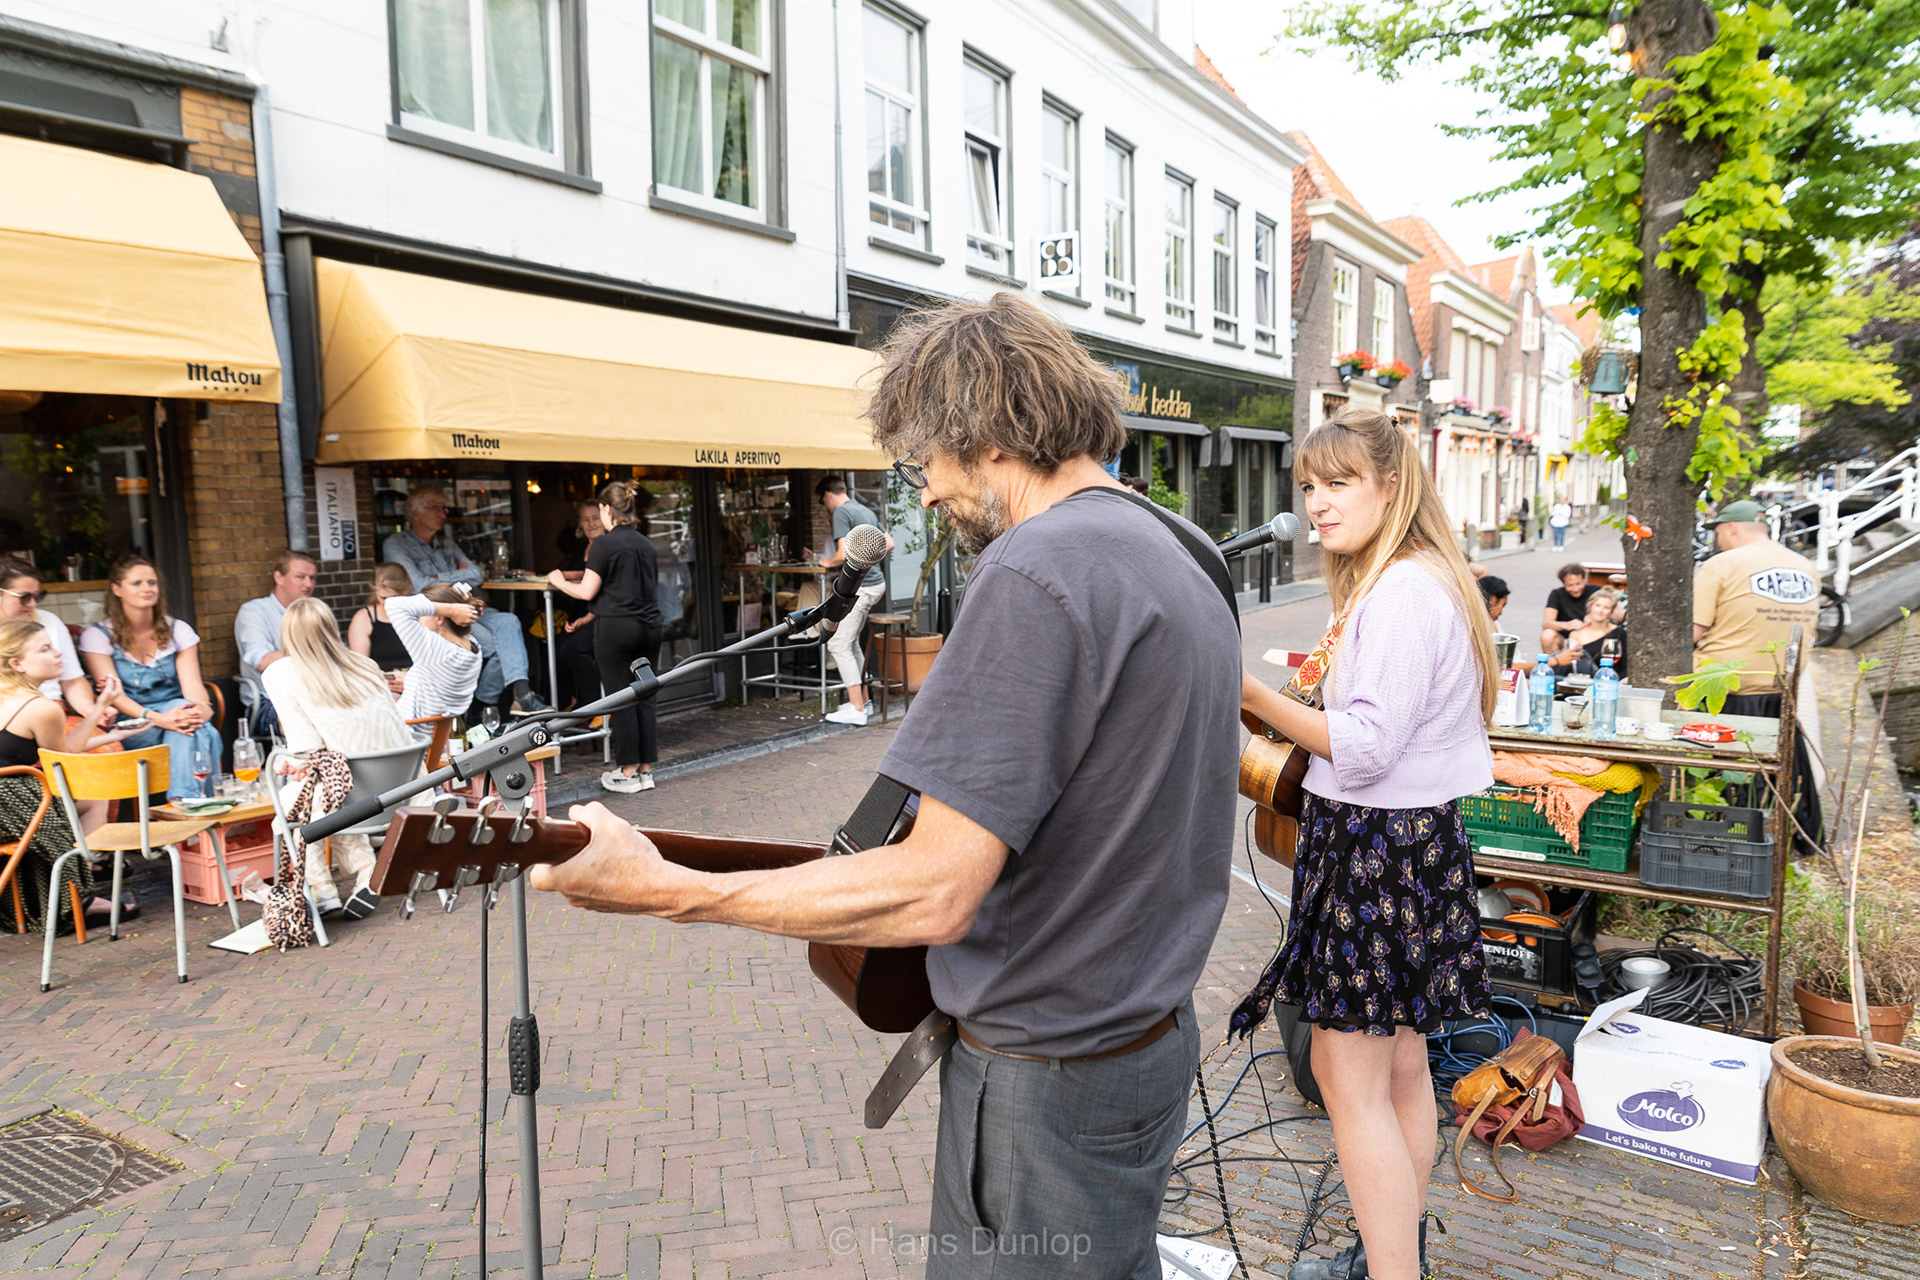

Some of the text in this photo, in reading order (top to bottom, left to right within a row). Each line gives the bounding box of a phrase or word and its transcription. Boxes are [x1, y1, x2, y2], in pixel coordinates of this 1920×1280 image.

[186, 362, 262, 386] Mahou
[1151, 385, 1192, 419] bedden
[452, 433, 500, 449] Mahou
[695, 449, 781, 465] LAKILA APERITIVO
[325, 482, 341, 549] ITALIANO
[1483, 944, 1534, 959] ENHOFF
[1621, 1098, 1694, 1127] Molco
[1605, 1131, 1713, 1168] Let's bake the future
